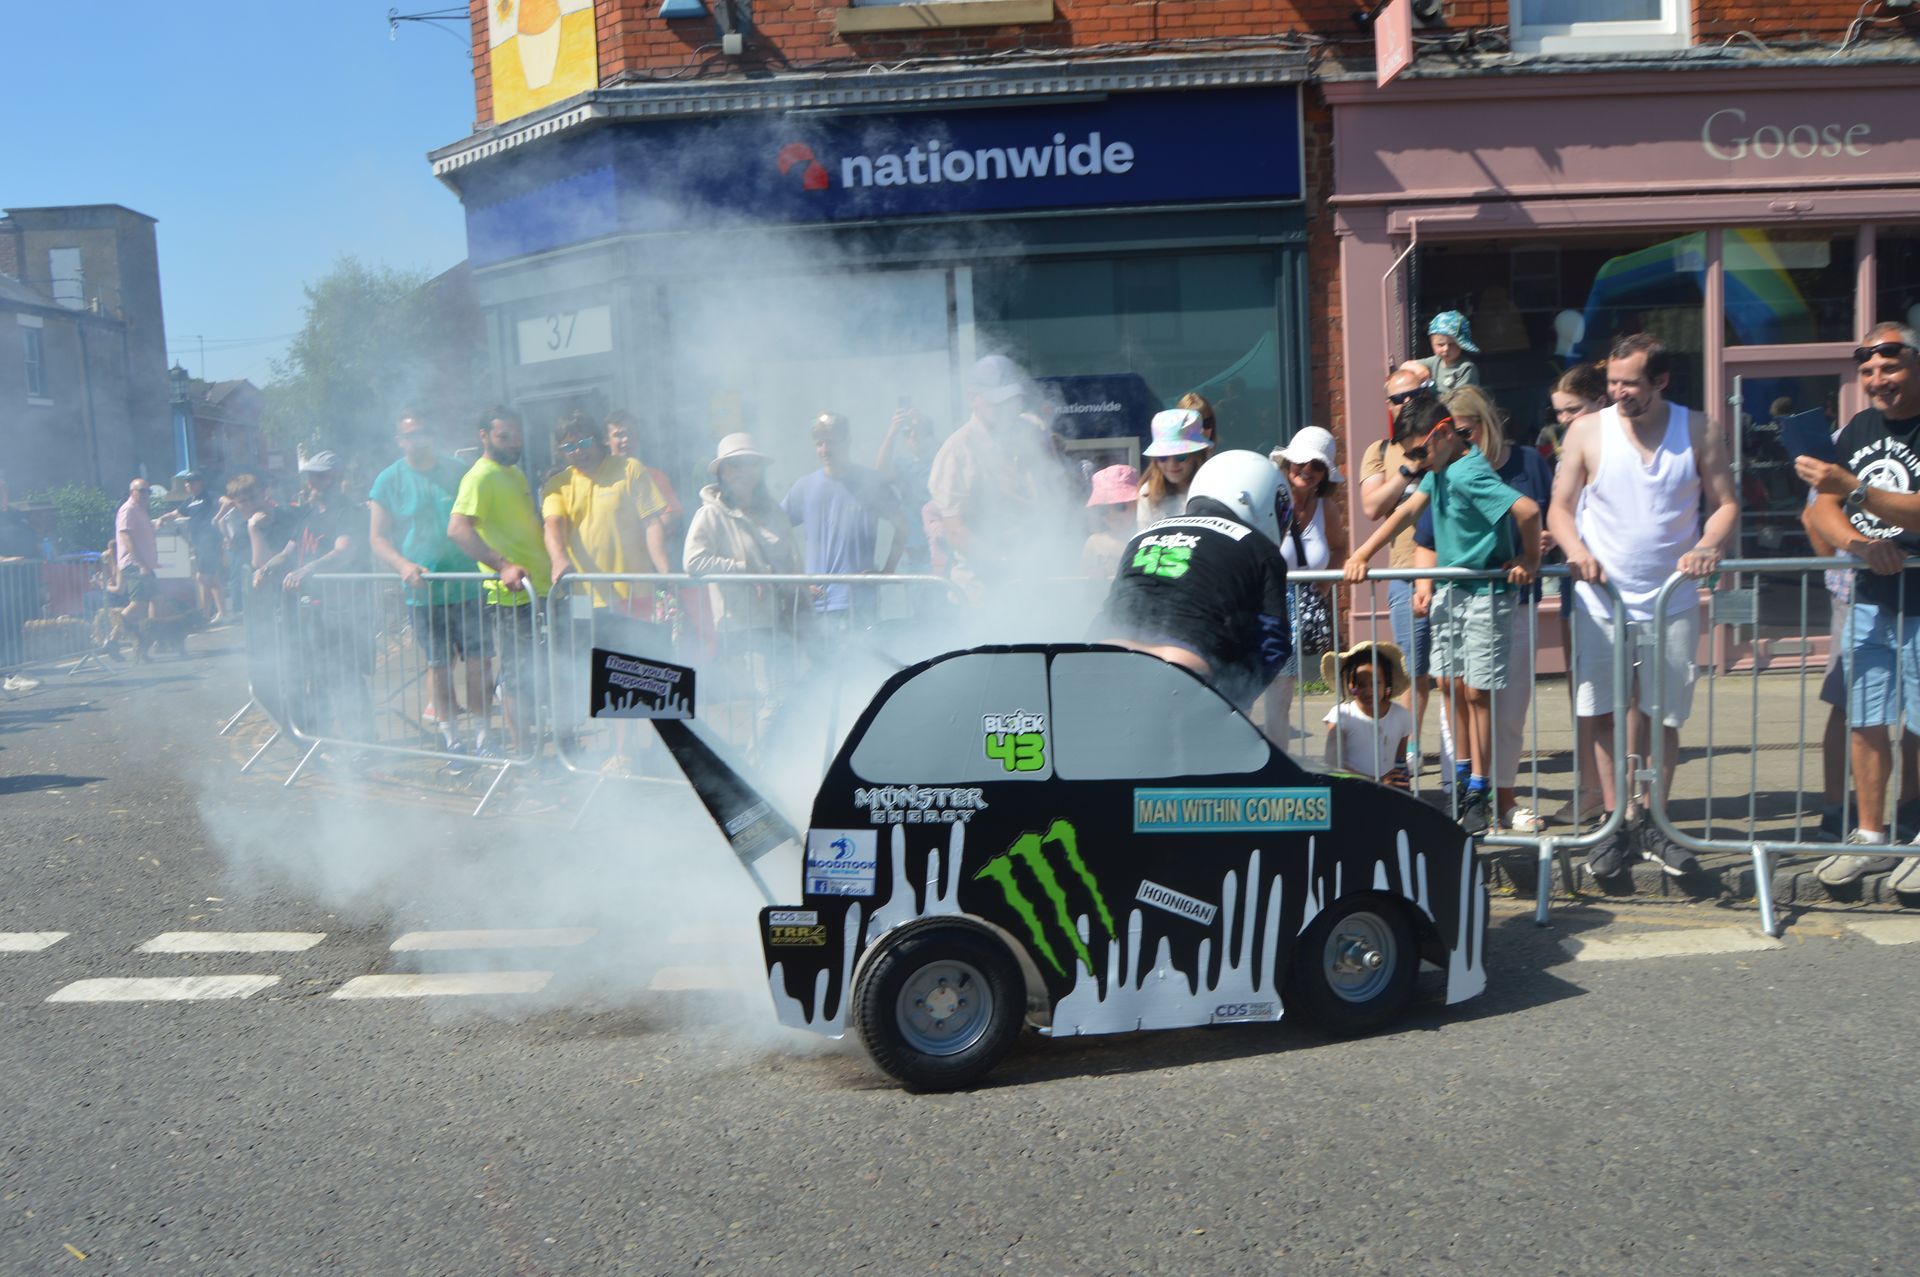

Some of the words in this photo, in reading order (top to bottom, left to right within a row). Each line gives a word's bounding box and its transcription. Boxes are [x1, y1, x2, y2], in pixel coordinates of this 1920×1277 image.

[1702, 108, 1872, 161] Goose
[841, 131, 1135, 188] nationwide
[546, 312, 577, 351] 37
[1055, 401, 1122, 414] nationwide
[1132, 545, 1193, 579] 43
[607, 658, 640, 673] Thank
[641, 666, 661, 678] you
[663, 668, 679, 680] for
[611, 673, 667, 695] supporting
[984, 710, 1045, 736] BLOCK
[986, 732, 1045, 772] 43
[854, 784, 989, 811] MONSTER
[1139, 800, 1177, 823] MAN
[1182, 799, 1241, 823] WITHIN
[1245, 798, 1328, 822] COMPASS
[870, 810, 976, 824] ENERGY
[1143, 884, 1212, 922] HOONIGAN
[771, 912, 796, 922] CDS
[1216, 1003, 1248, 1017] CDS
